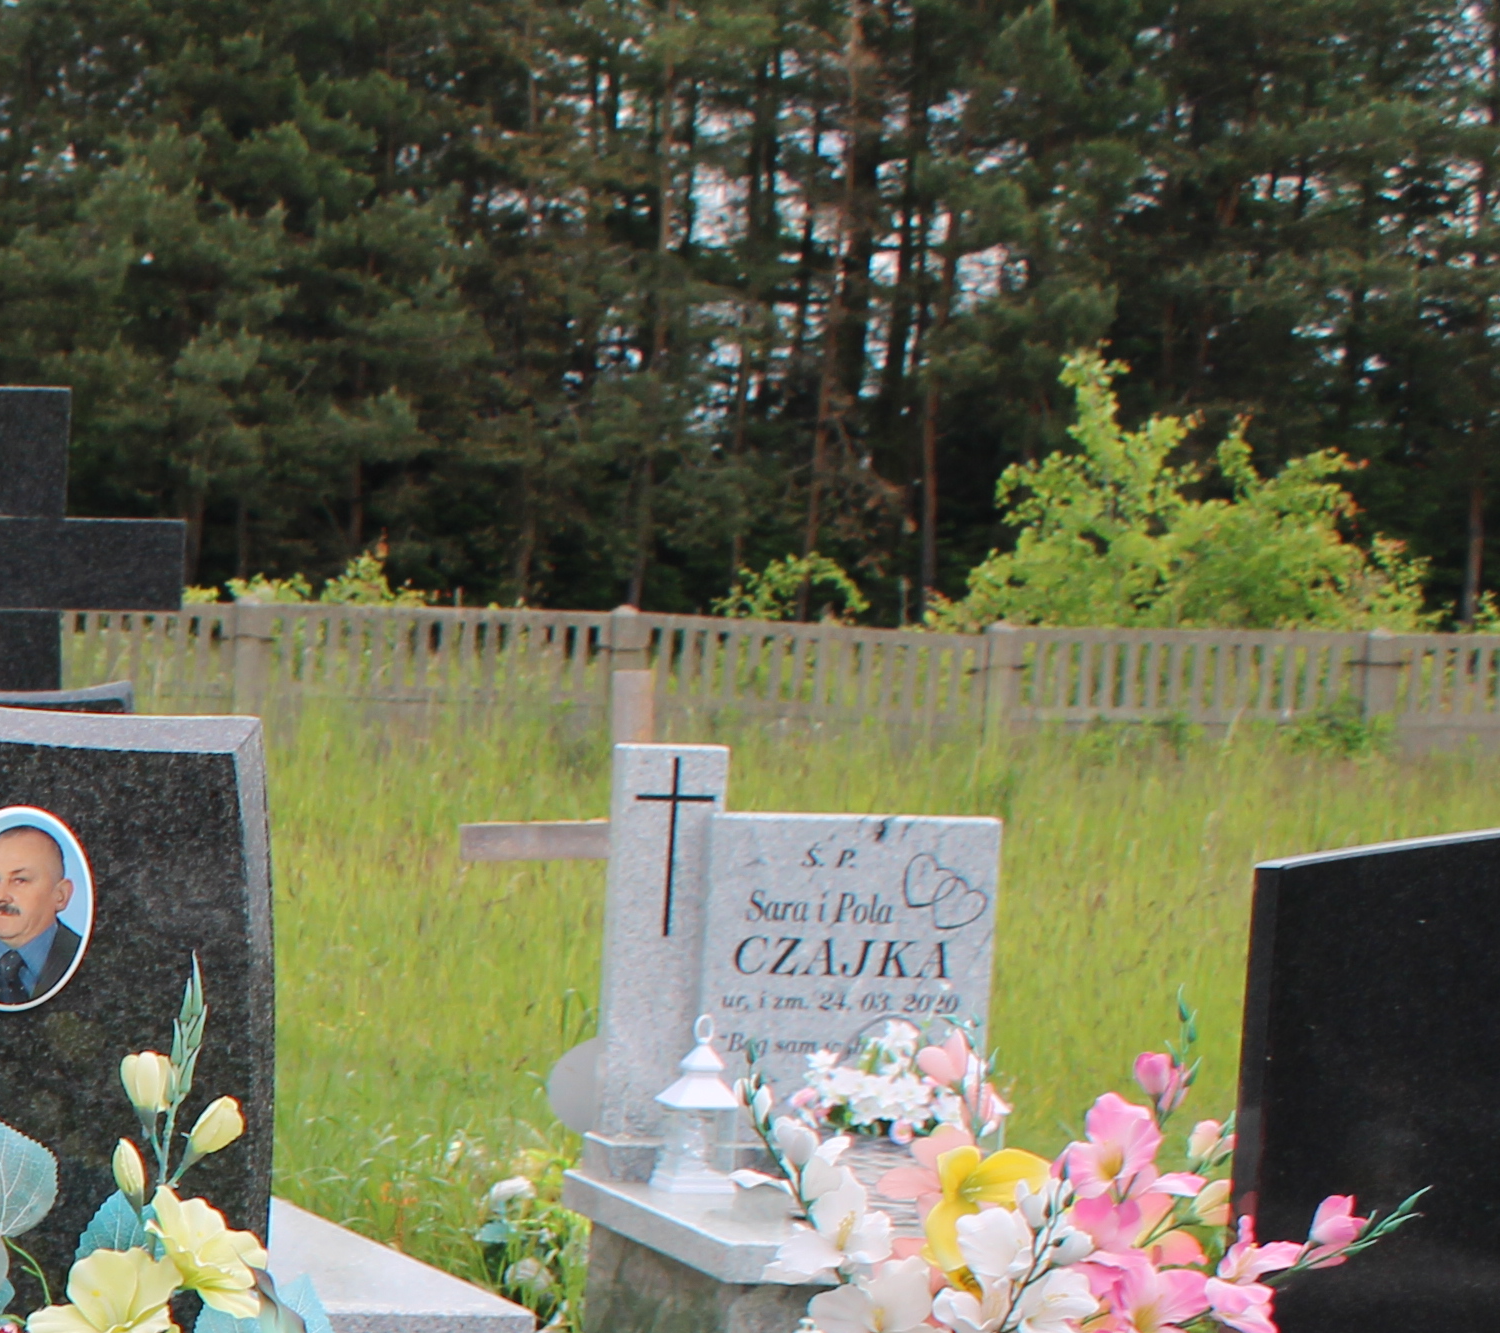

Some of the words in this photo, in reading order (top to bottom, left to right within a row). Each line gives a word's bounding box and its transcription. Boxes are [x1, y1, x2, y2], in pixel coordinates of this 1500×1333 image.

[746, 890, 808, 923] Sara
[818, 891, 829, 923] i
[834, 892, 893, 925] Pola
[734, 936, 949, 979] CZAJKA
[902, 993, 960, 1015] 2020
